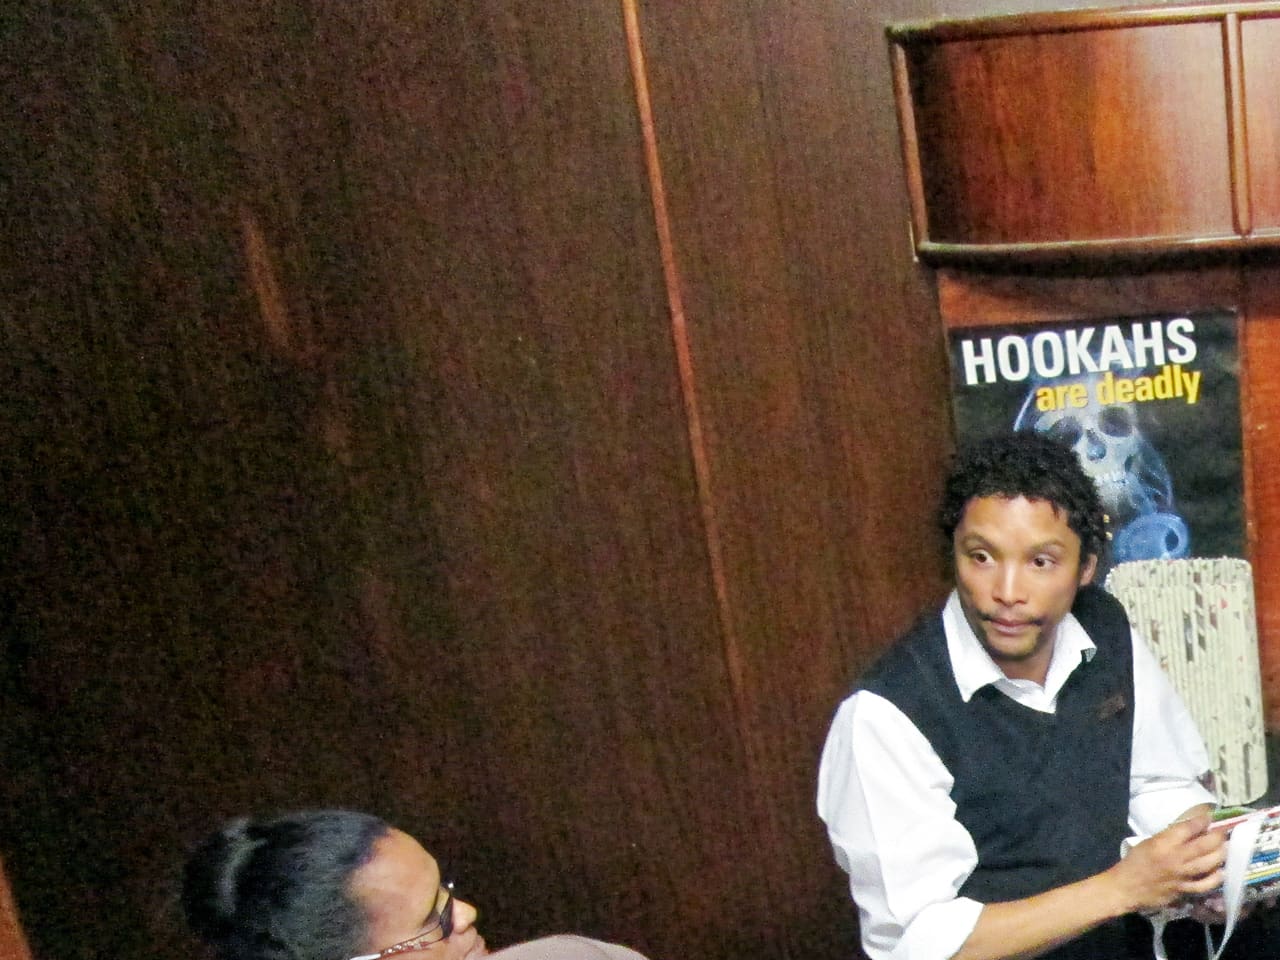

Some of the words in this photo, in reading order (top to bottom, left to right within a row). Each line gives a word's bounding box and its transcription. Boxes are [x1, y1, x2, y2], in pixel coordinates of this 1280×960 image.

[961, 318, 1197, 385] HOOKAHS
[1036, 384, 1089, 413] are
[1095, 364, 1202, 405] deadly
